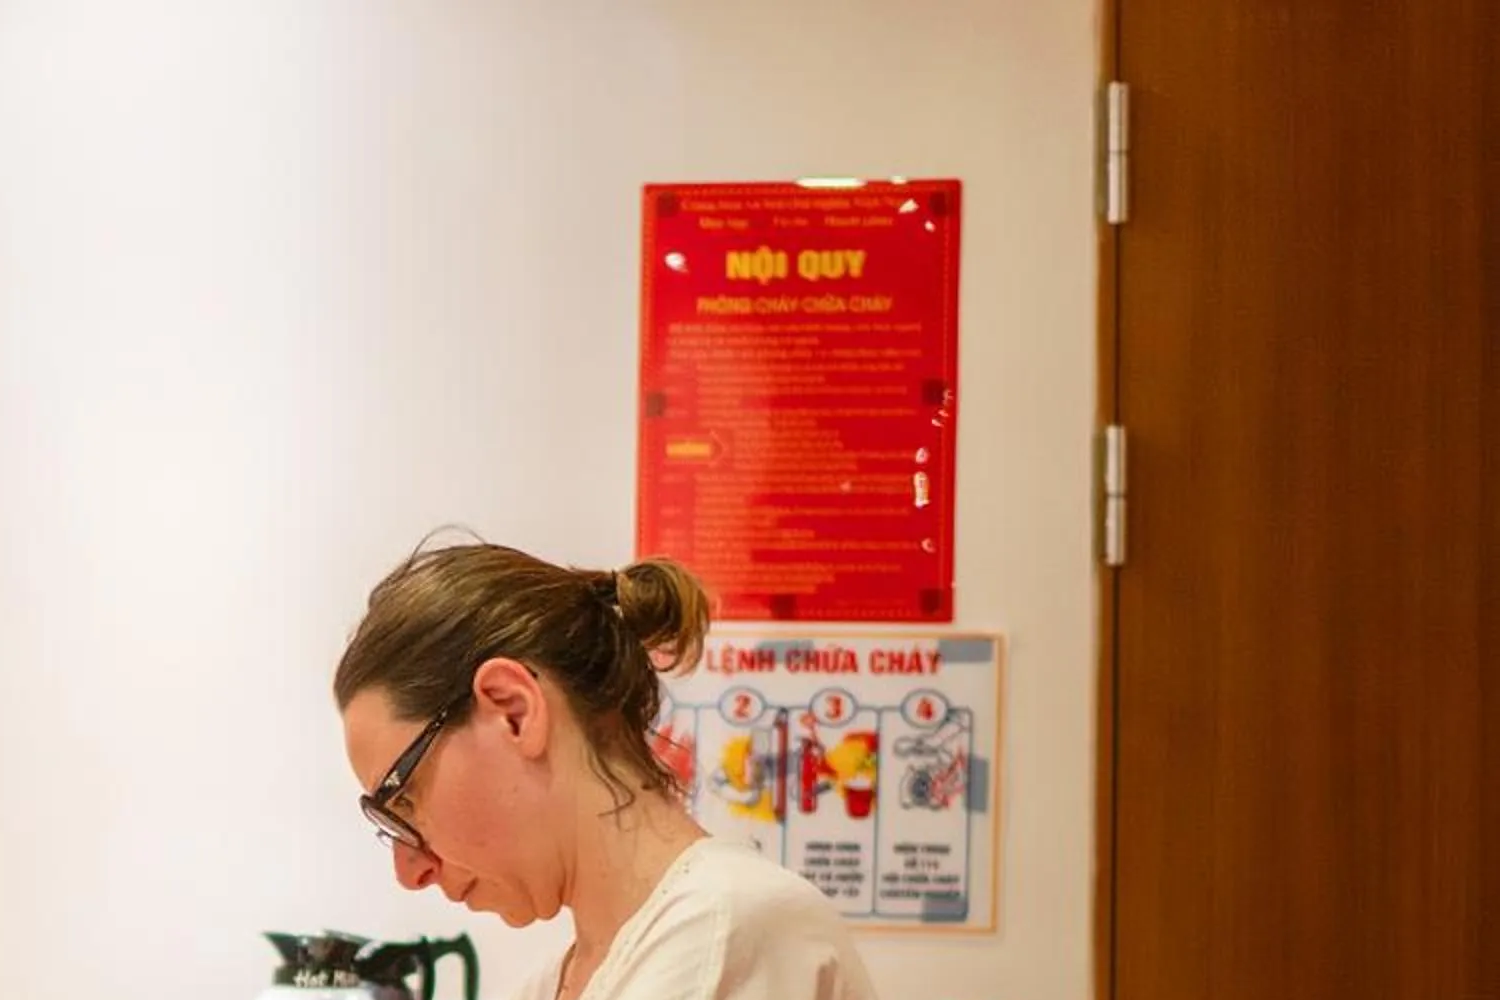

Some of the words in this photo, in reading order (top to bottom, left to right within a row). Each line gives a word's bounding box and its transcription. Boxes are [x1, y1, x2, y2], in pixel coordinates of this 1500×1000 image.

[726, 245, 788, 285] NỘI
[797, 249, 866, 281] QUY
[705, 641, 776, 676] LỆNH
[784, 643, 859, 674] CHỮA
[868, 643, 943, 674] CHÁY
[732, 694, 751, 719] 2
[824, 695, 843, 719] 3
[915, 698, 934, 720] 4
[293, 967, 329, 988] Hot
